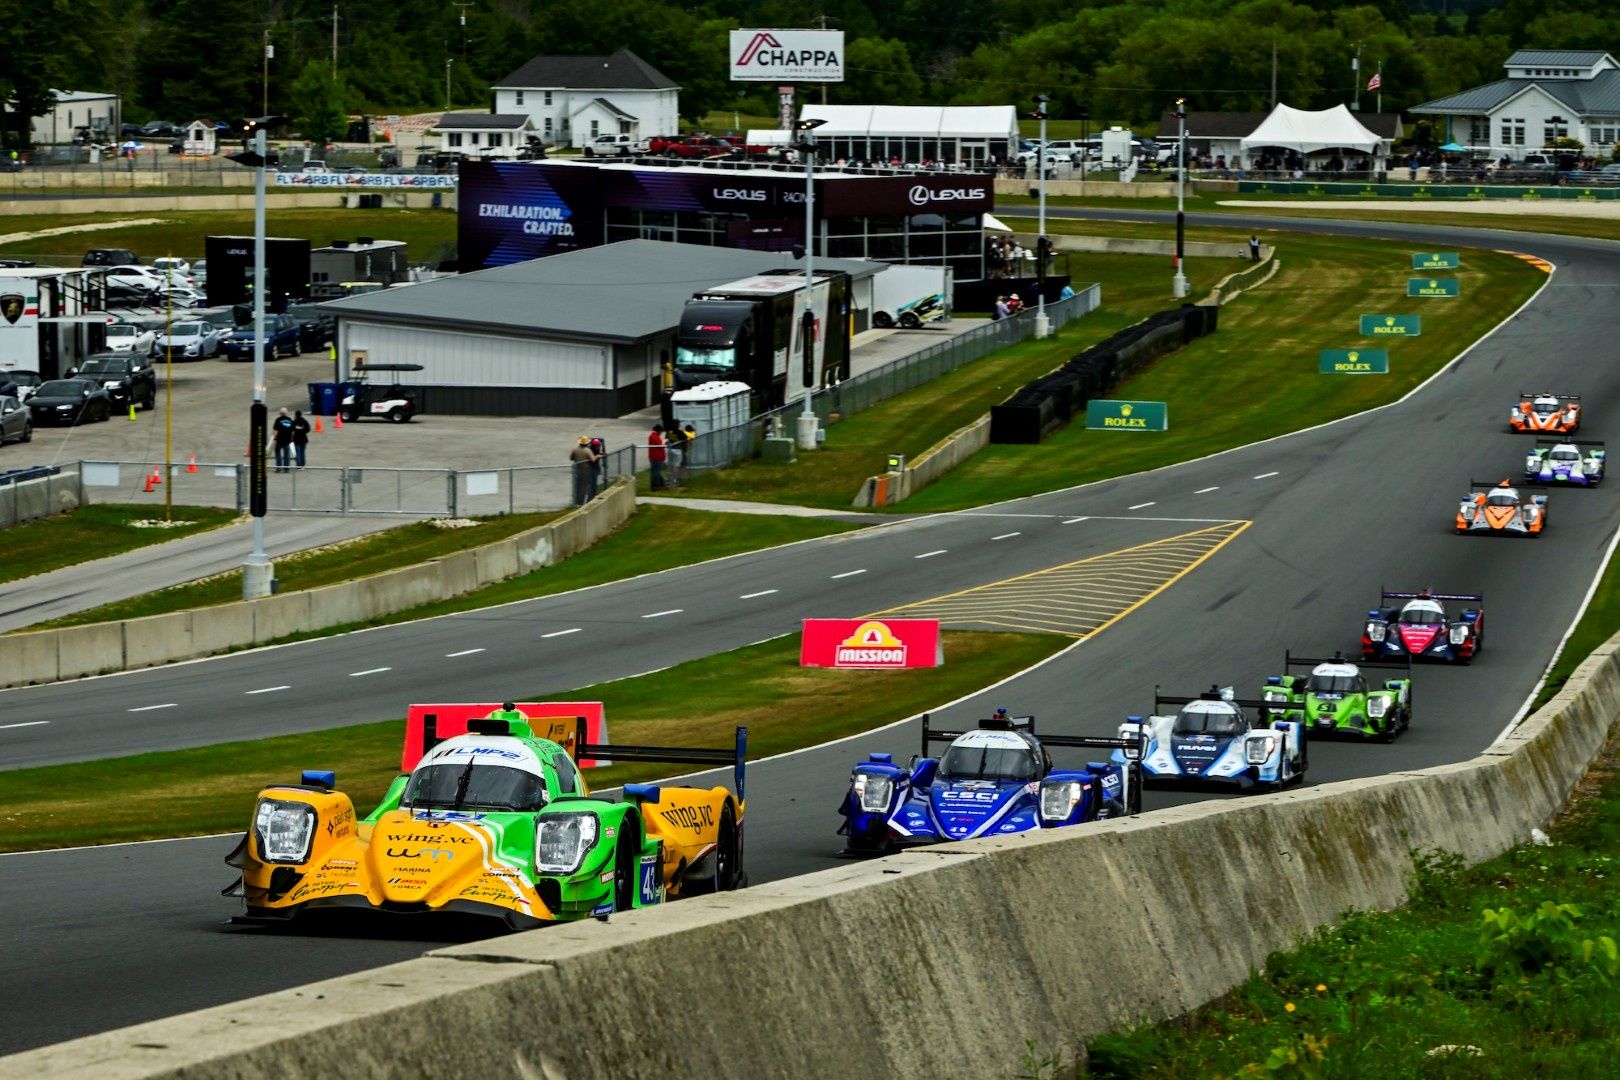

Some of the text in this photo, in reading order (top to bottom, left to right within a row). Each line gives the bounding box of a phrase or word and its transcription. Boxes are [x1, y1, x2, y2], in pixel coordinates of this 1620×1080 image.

[757, 50, 839, 66] CHAPPA
[713, 188, 766, 201] LEXUS
[930, 188, 986, 201] LEXUS
[479, 203, 564, 220] EXHILARATION.
[523, 221, 575, 236] CRAFTED.
[1104, 417, 1146, 427] ROLEX
[455, 747, 521, 760] LMP2
[942, 791, 1000, 800] CSCI
[660, 802, 714, 834] wing.vc
[387, 834, 474, 845] wing.vc
